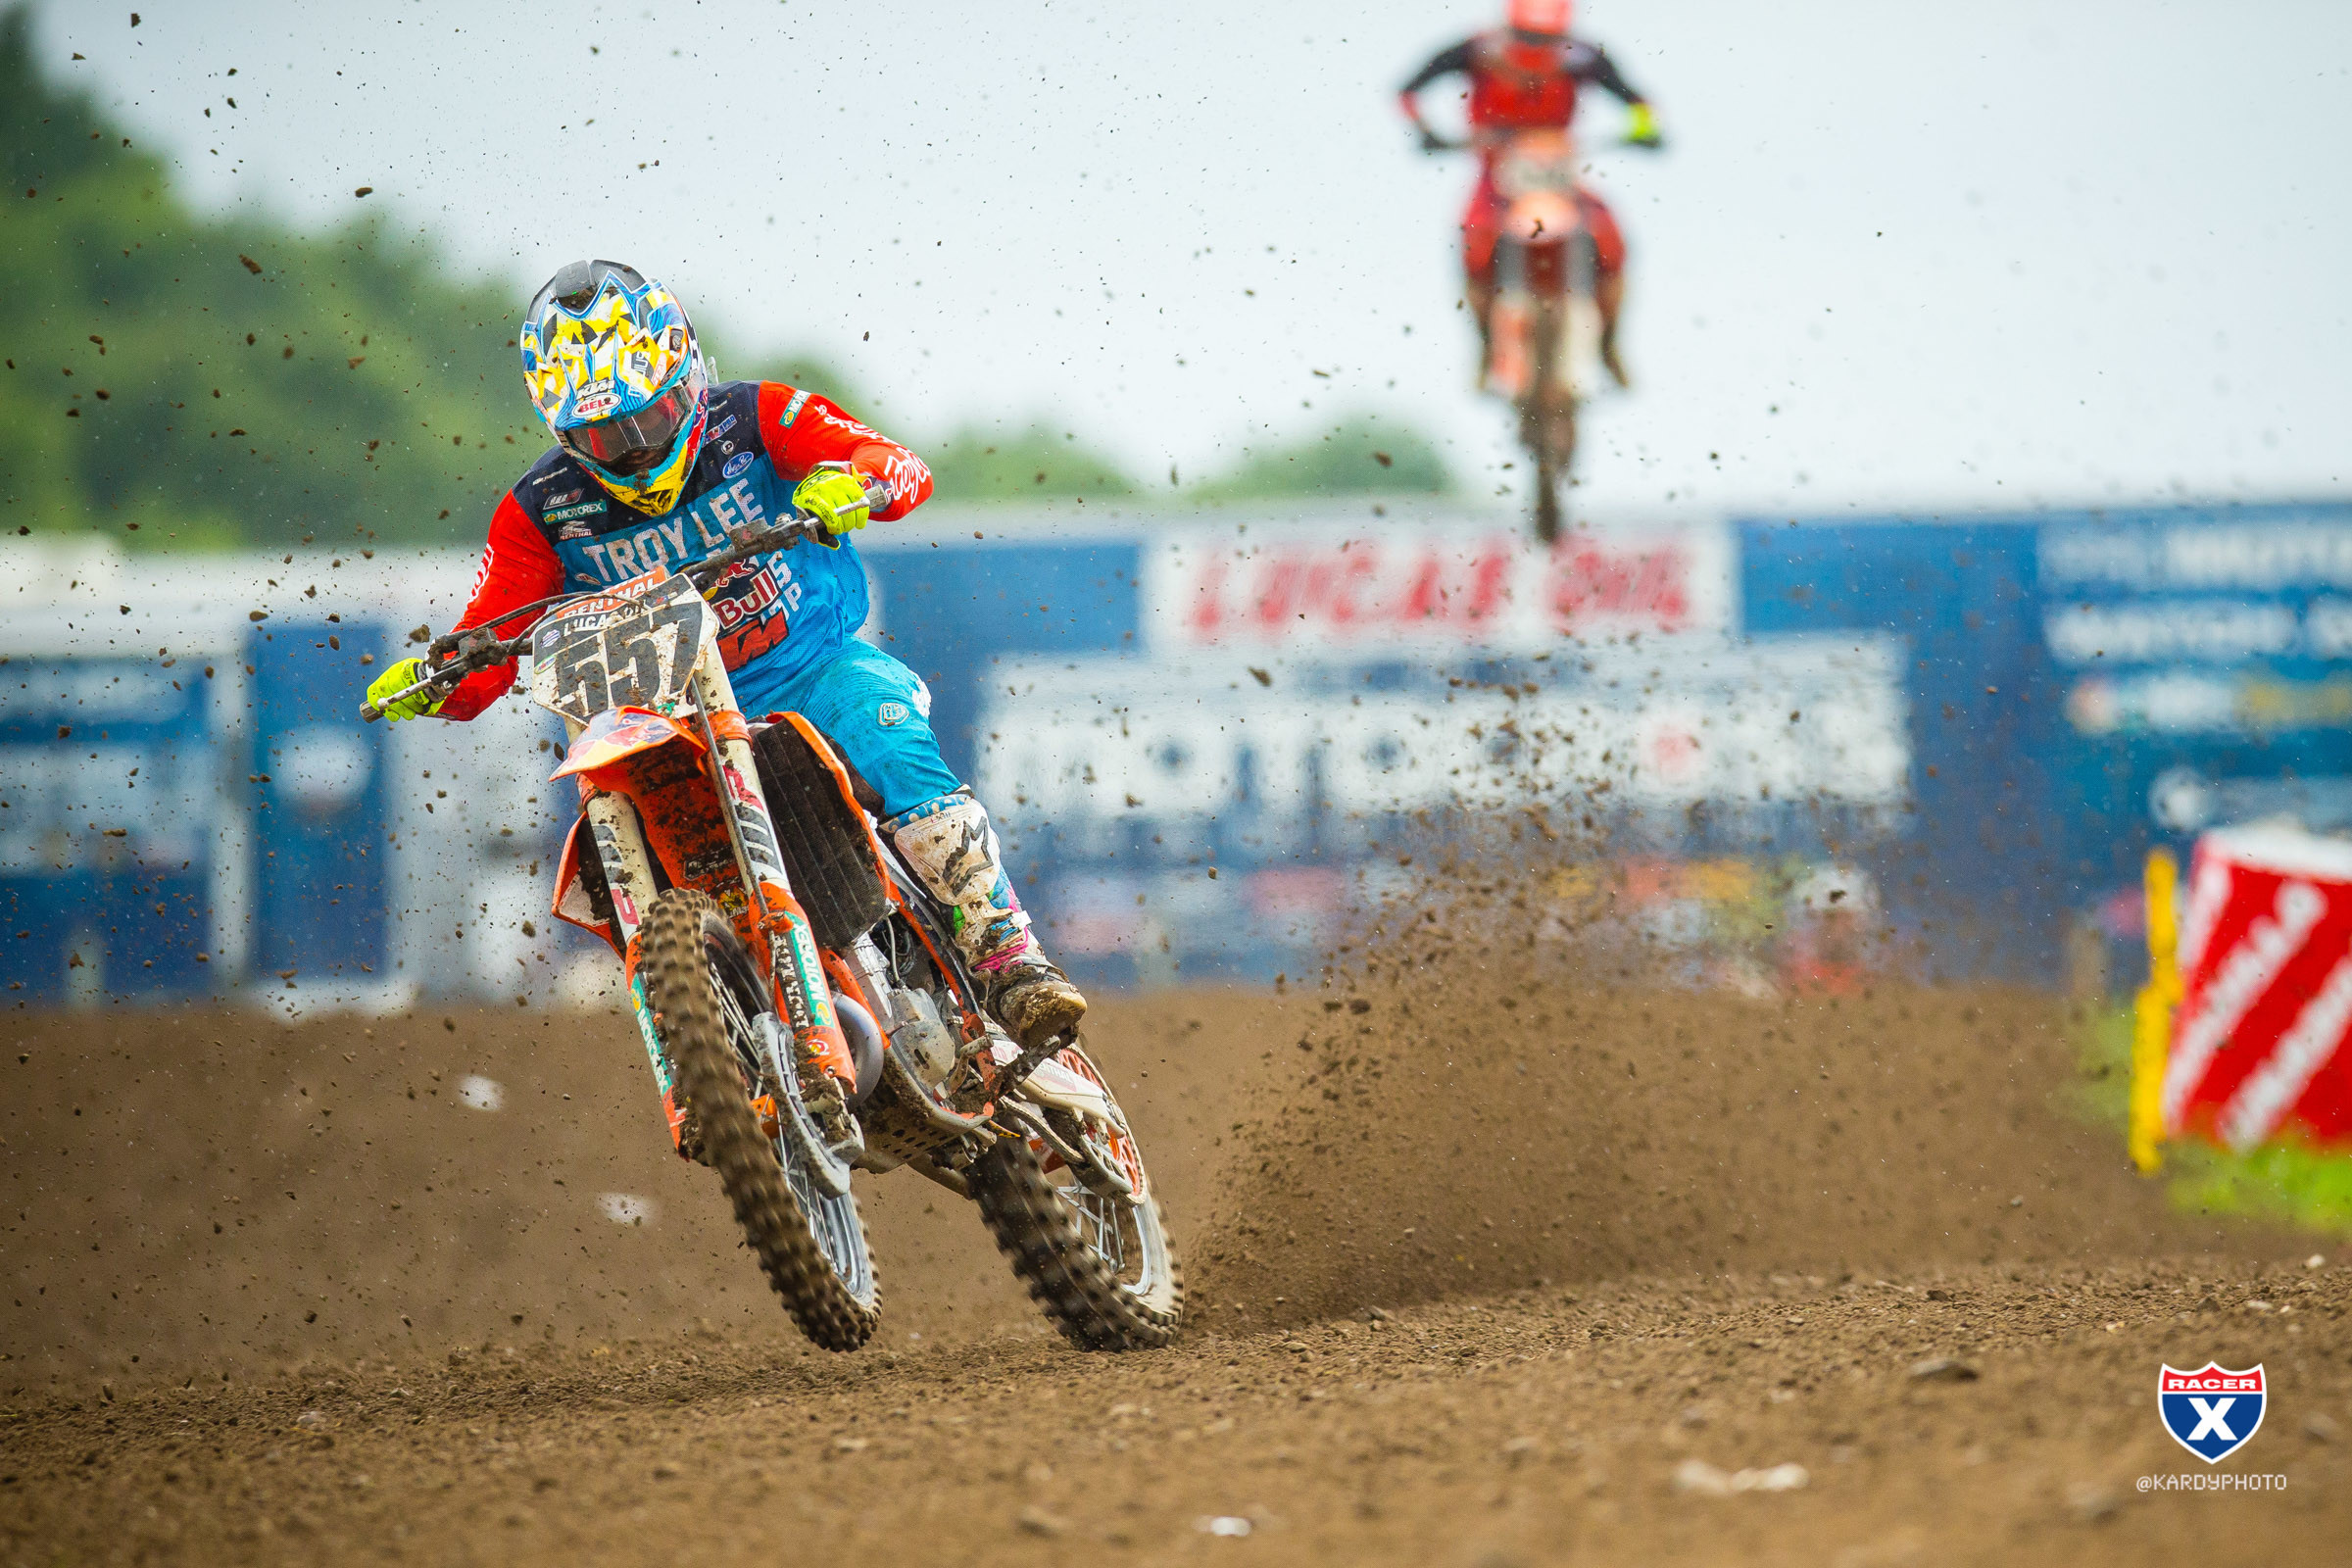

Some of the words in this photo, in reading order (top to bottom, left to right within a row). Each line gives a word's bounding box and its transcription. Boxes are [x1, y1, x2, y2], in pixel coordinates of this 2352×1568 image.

[578, 396, 613, 415] BELL
[557, 502, 604, 520] MOTOREX
[582, 515, 689, 582] TROY
[691, 477, 764, 549] LEE
[564, 610, 621, 637] LUCA
[712, 568, 780, 629] Bull
[557, 601, 703, 723] 557
[795, 922, 827, 1004] MOTOREX
